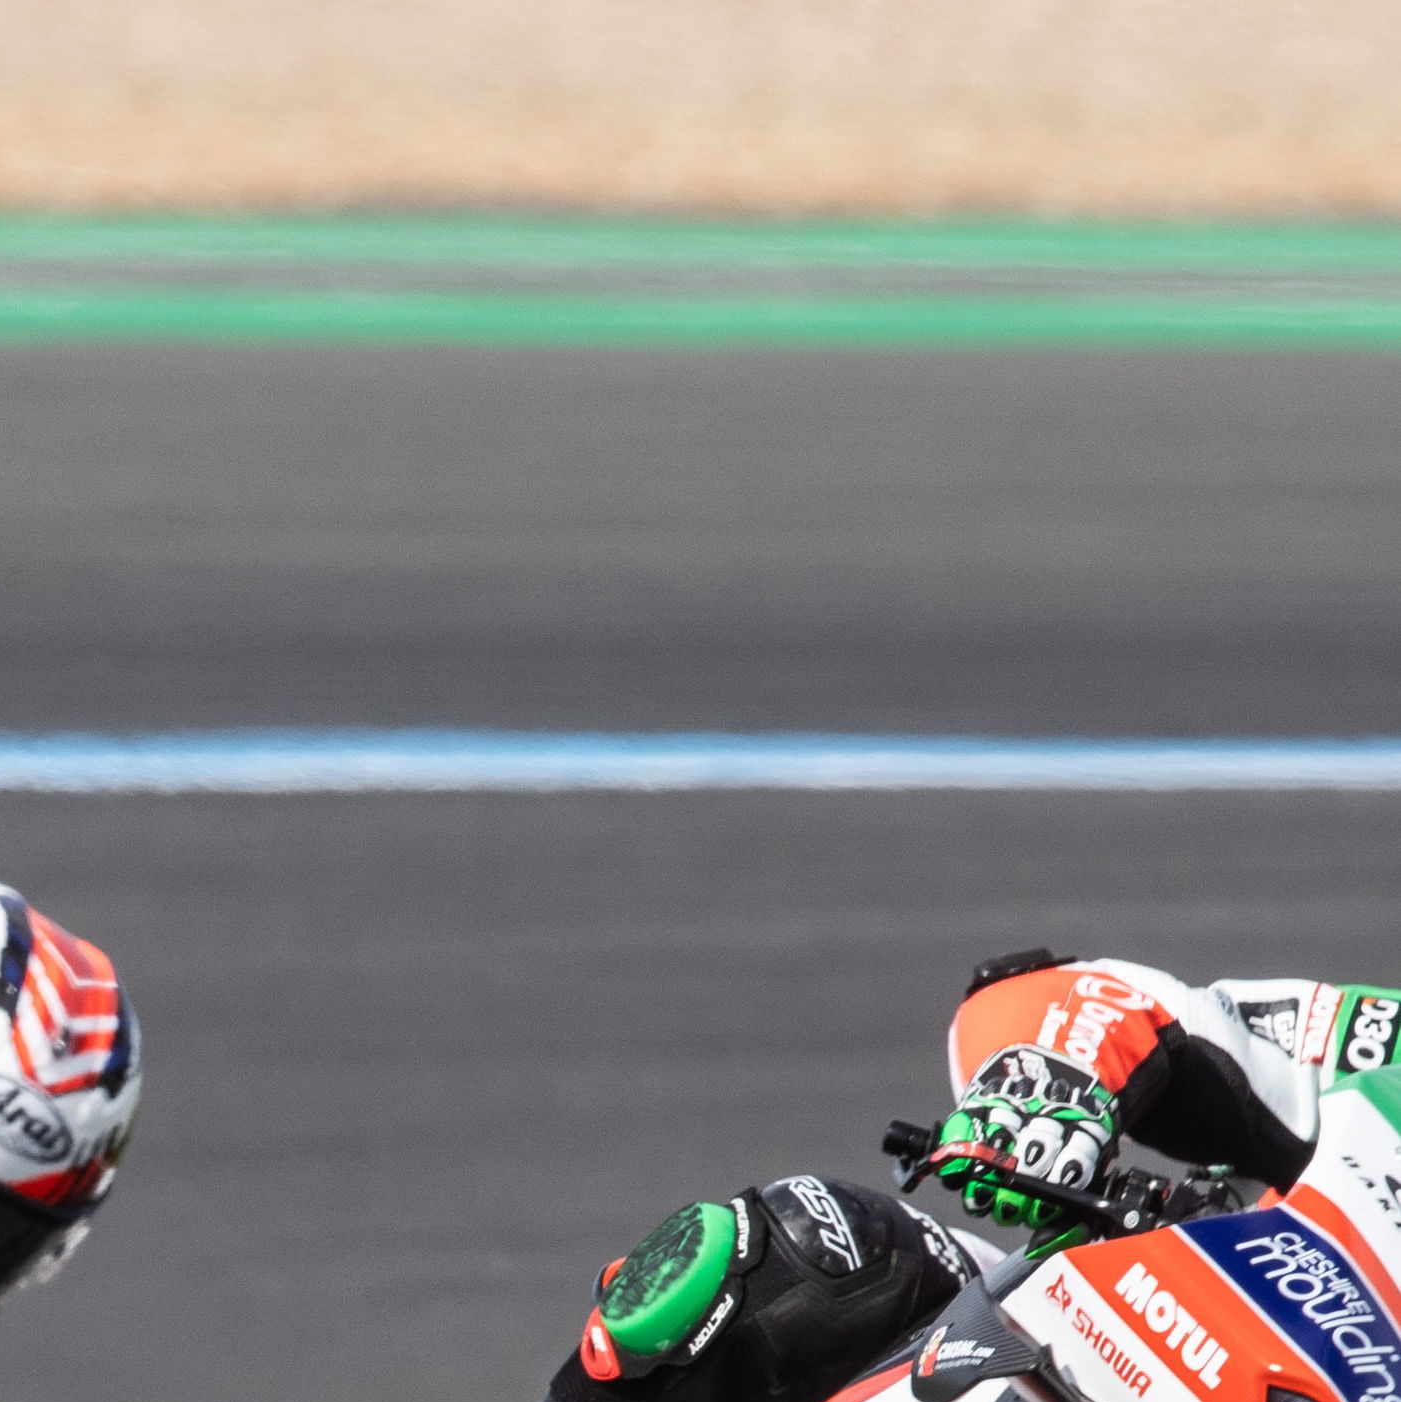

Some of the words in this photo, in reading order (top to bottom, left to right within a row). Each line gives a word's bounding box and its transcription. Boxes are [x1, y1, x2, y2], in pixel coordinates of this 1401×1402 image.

[1273, 1231, 1372, 1316] CHESHIRE
[1071, 1306, 1154, 1398] SHOWA
[1114, 1261, 1230, 1390] MOTUL
